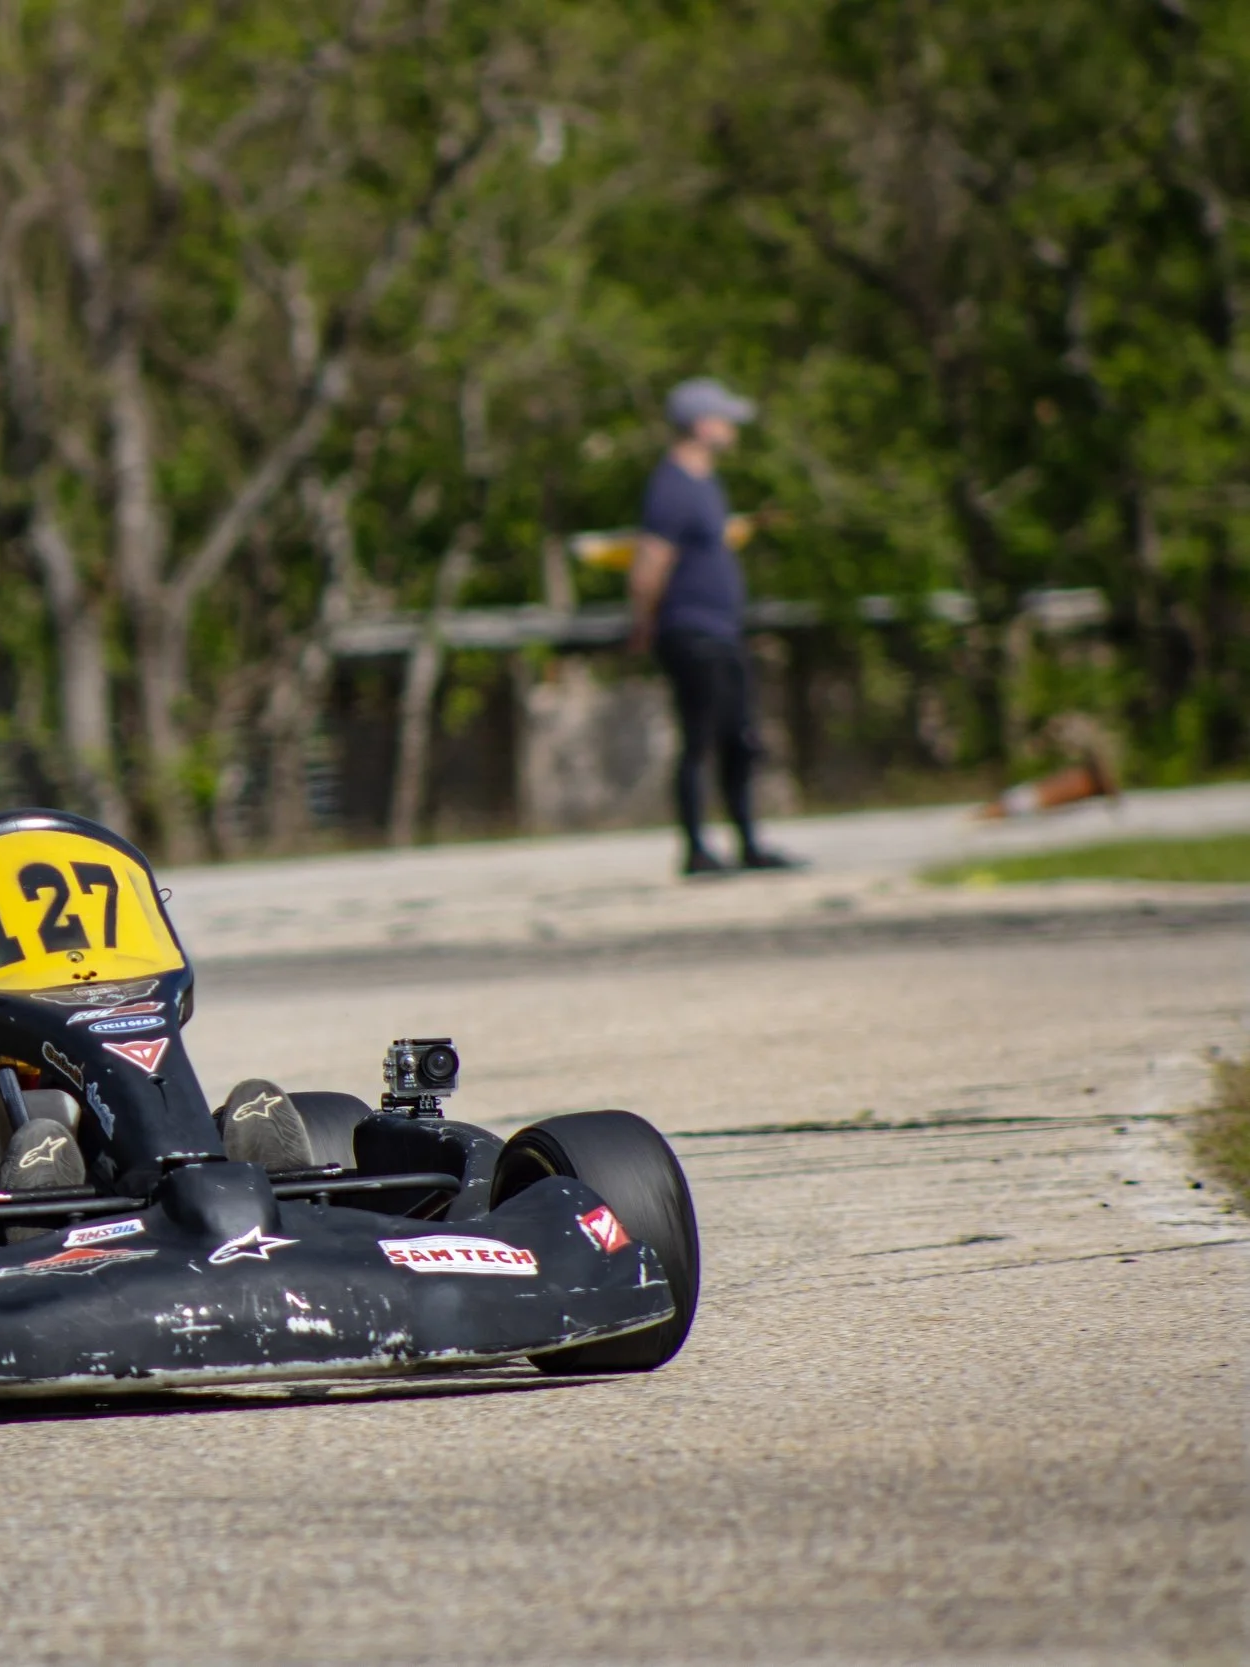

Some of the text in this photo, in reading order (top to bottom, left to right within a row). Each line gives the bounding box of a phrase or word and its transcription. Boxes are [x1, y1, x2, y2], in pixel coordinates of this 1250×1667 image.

[94, 1018, 158, 1031] CYCLE GEAR
[74, 1223, 138, 1244] AMSOIL
